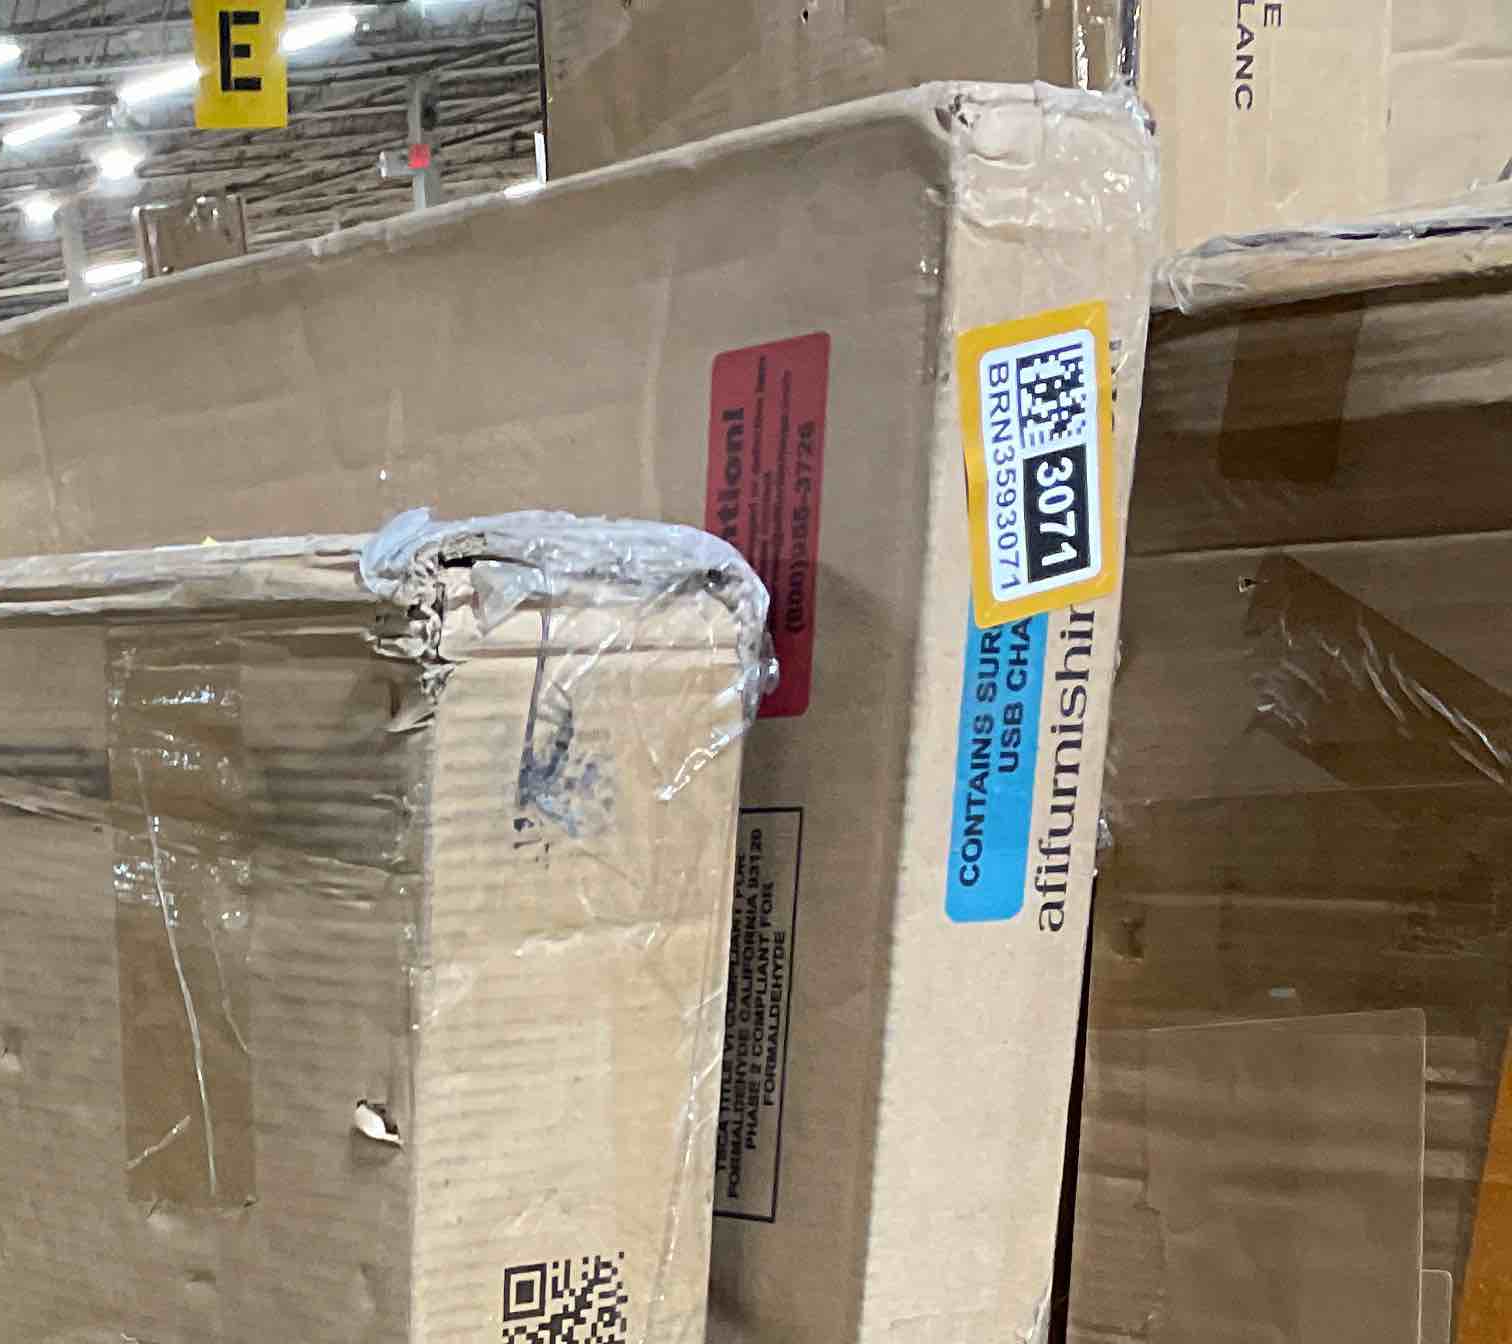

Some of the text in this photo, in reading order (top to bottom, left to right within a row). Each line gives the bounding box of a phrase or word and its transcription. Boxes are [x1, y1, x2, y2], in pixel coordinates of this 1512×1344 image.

[218, 9, 262, 92] E
[987, 361, 1022, 590] BRN3593071
[1036, 455, 1079, 569] 3071
[998, 701, 1025, 774] USB
[960, 706, 995, 888] CONTAINS
[762, 880, 774, 928] FOR
[751, 936, 770, 1060] COMPLIANT
[763, 929, 786, 1107] FORMALDEHYDE
[745, 1098, 760, 1150] PHASE
